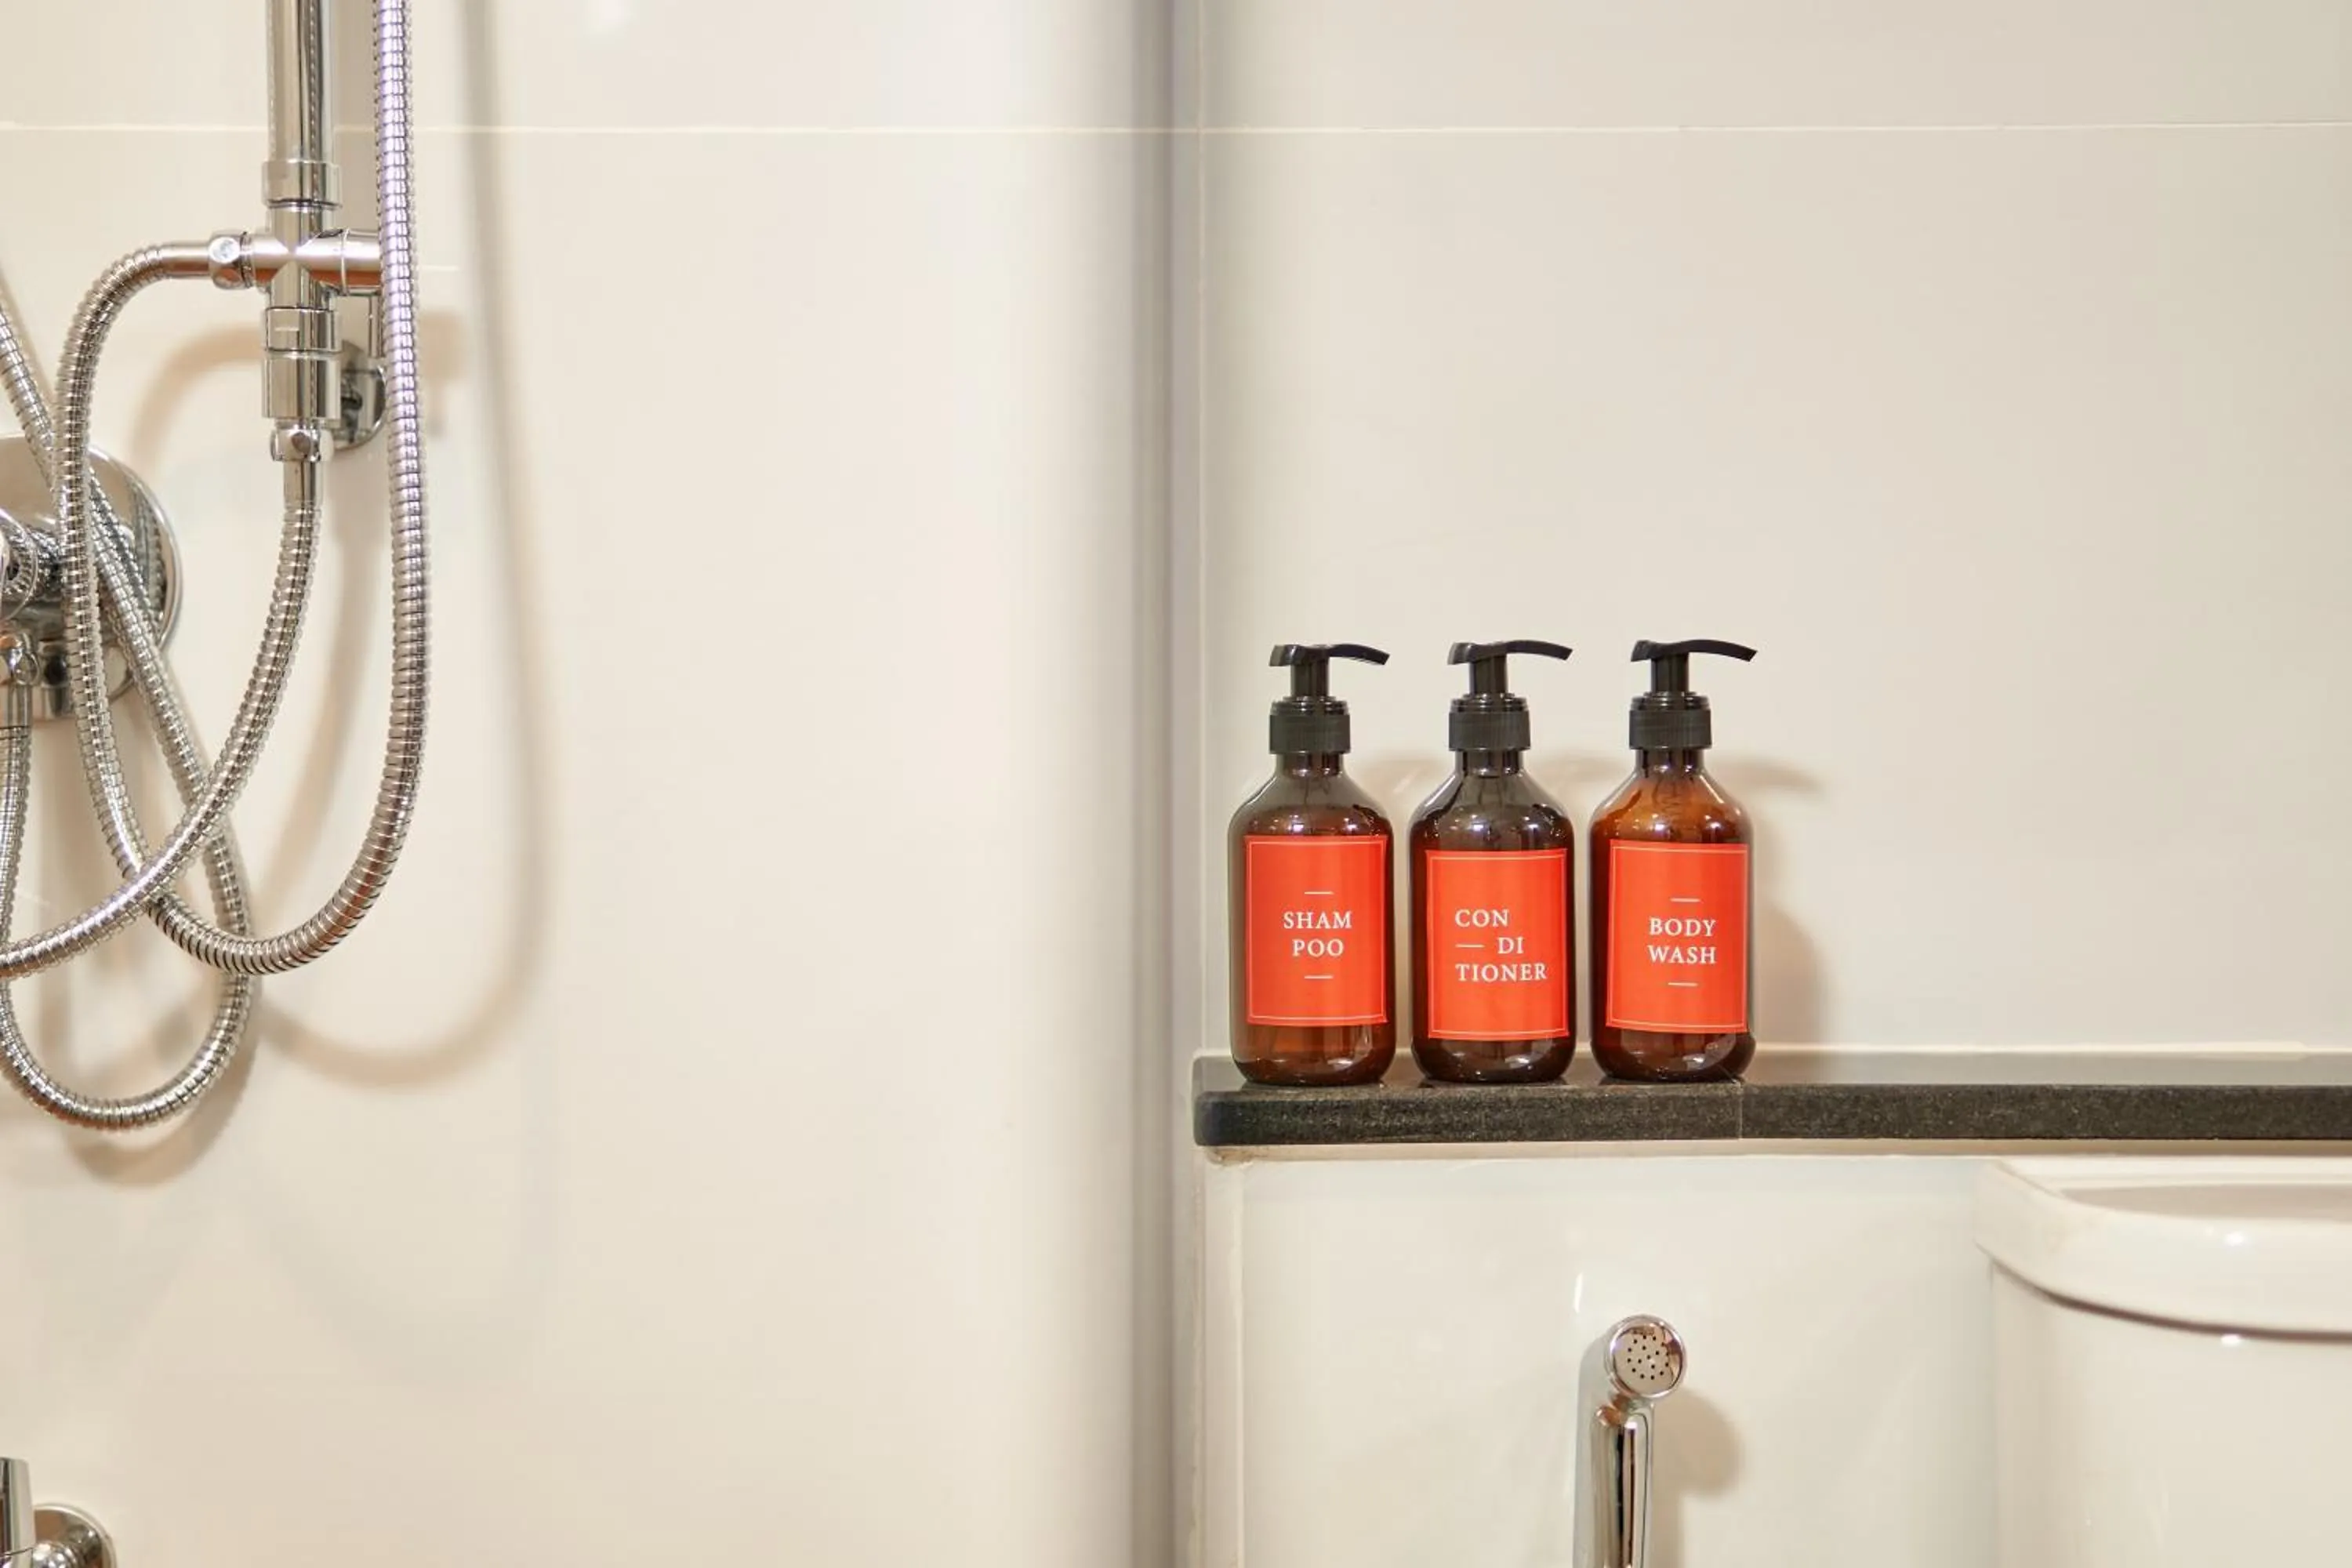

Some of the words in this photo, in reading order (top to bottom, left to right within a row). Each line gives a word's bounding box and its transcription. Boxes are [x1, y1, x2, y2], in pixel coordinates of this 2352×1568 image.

[1283, 910, 1352, 929] SHAM
[1454, 909, 1509, 927] CON
[1649, 917, 1716, 937] BODY
[1292, 938, 1345, 957] POO
[1497, 936, 1524, 955] DI
[1648, 945, 1717, 964] WASH
[1455, 963, 1547, 982] TIONER
